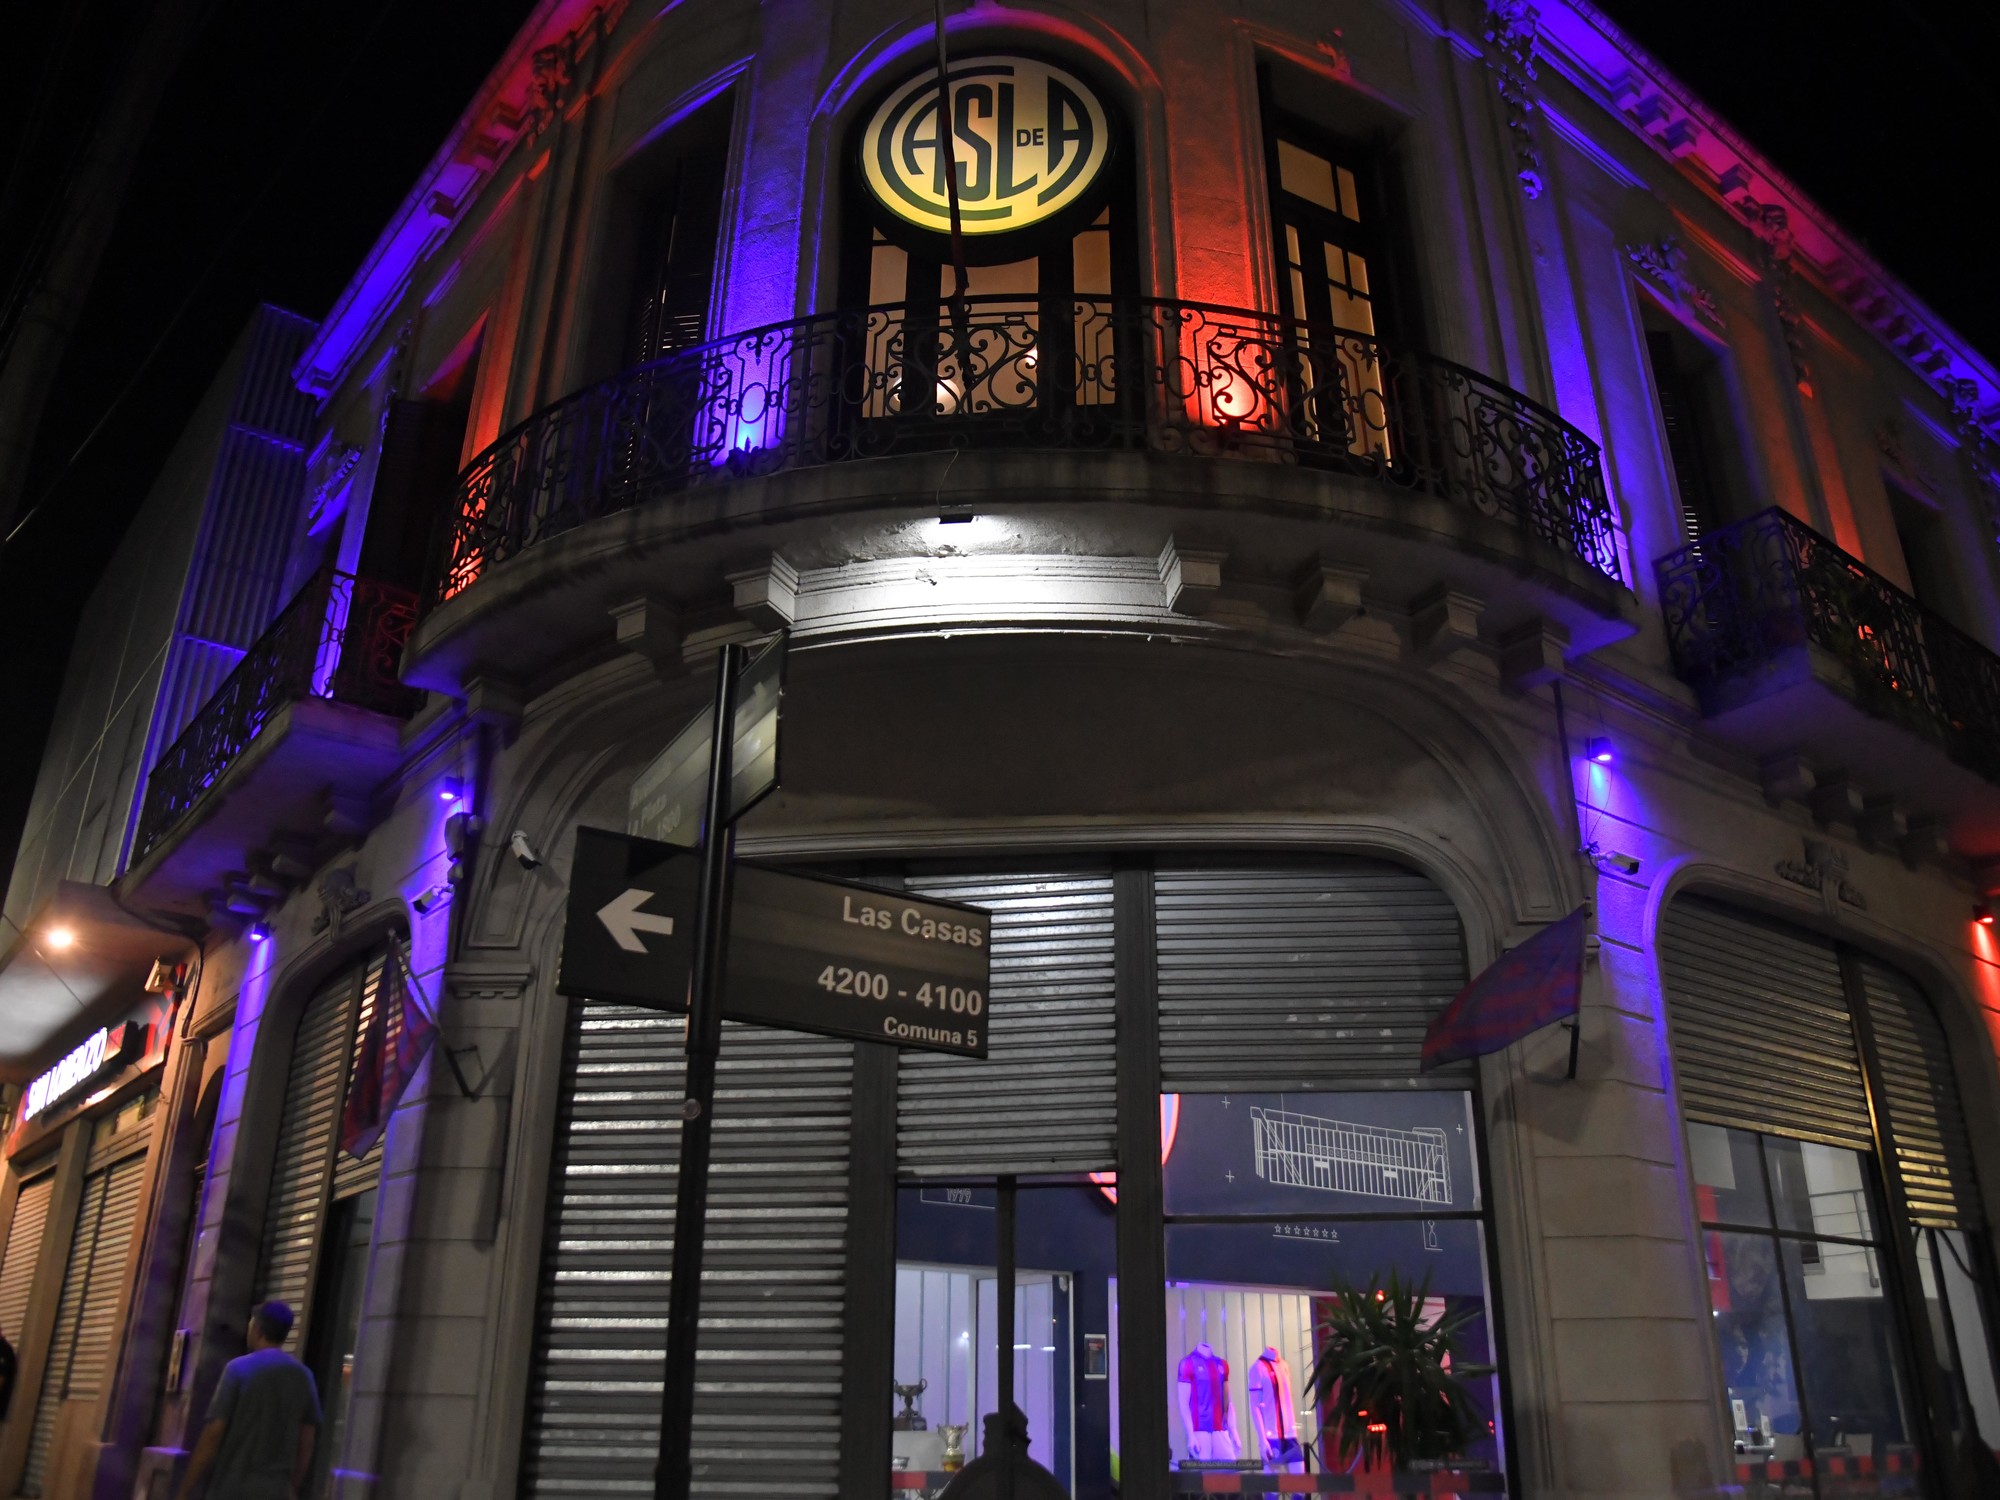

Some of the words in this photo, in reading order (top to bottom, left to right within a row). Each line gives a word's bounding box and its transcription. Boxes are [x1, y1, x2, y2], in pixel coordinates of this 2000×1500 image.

[843, 896, 892, 930] Las
[901, 908, 983, 947] Casas
[817, 965, 889, 1001] 4200
[915, 982, 982, 1016] 4100
[883, 1016, 962, 1045] Comuna
[967, 1030, 978, 1048] 5
